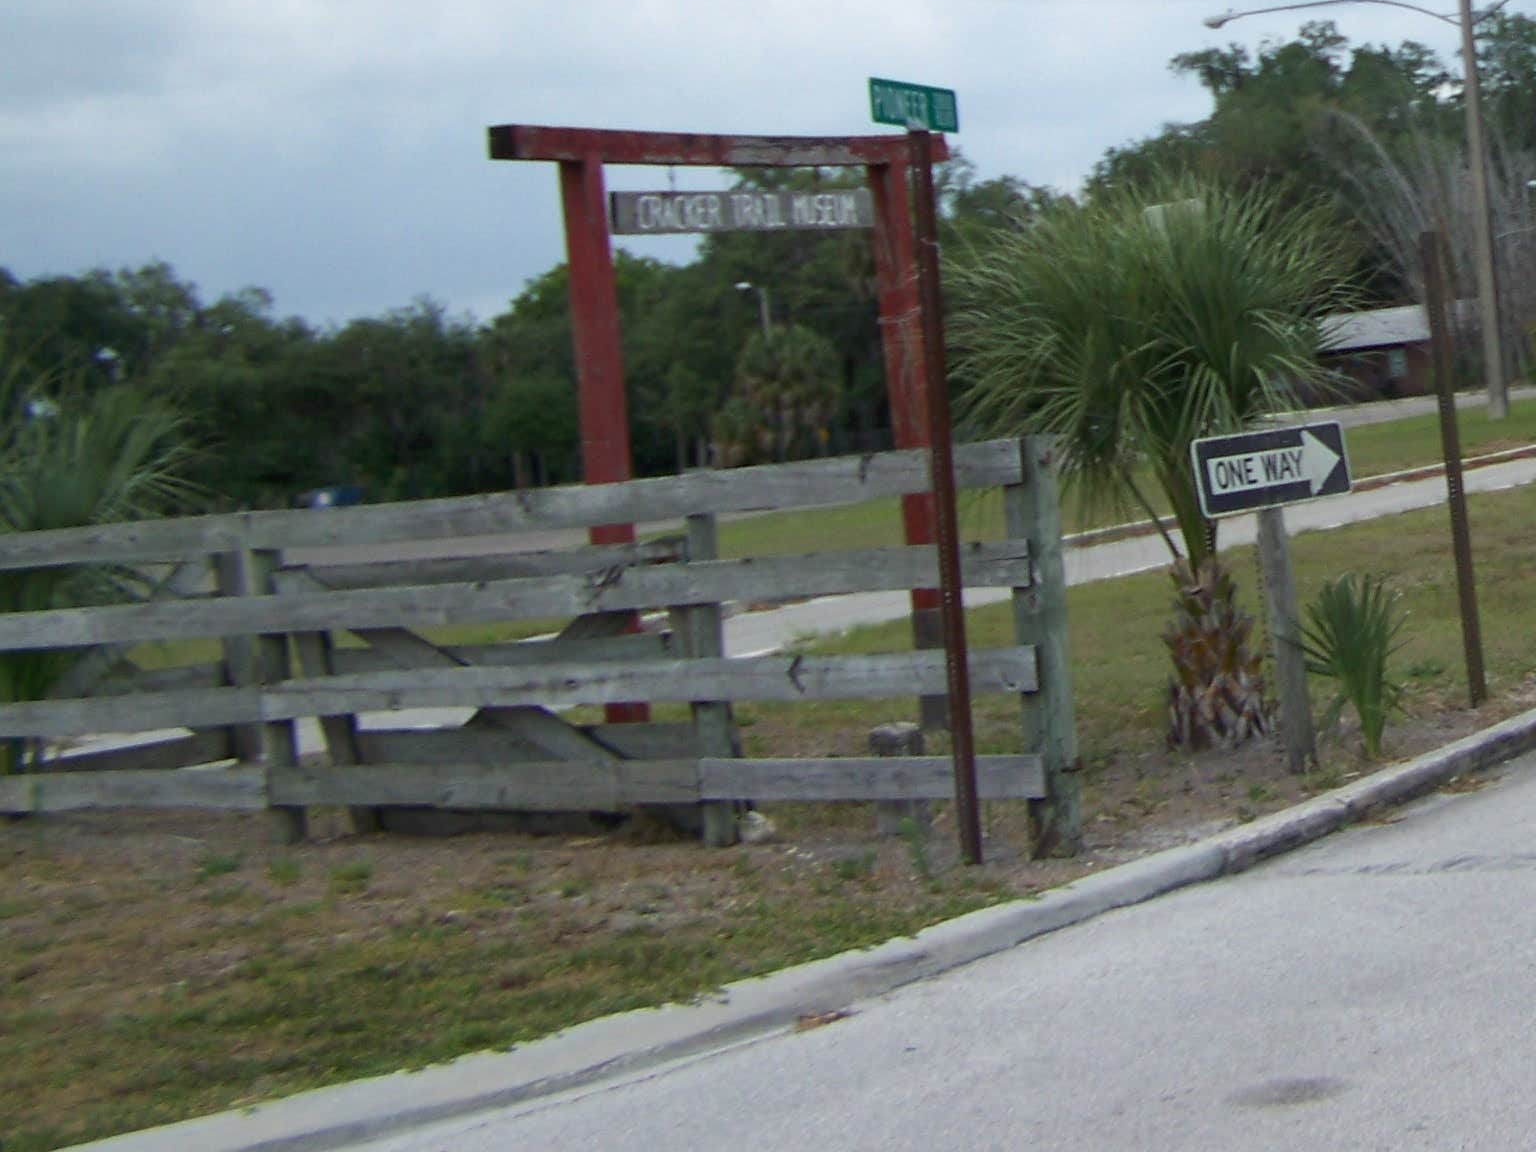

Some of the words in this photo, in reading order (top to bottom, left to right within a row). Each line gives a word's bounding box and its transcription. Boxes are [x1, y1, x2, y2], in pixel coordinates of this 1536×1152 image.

[636, 194, 721, 230] CRACKER
[731, 193, 786, 227] TRAIL
[792, 193, 858, 225] MUSEUM
[1215, 457, 1258, 490] ONE
[1260, 449, 1303, 483] WAY
